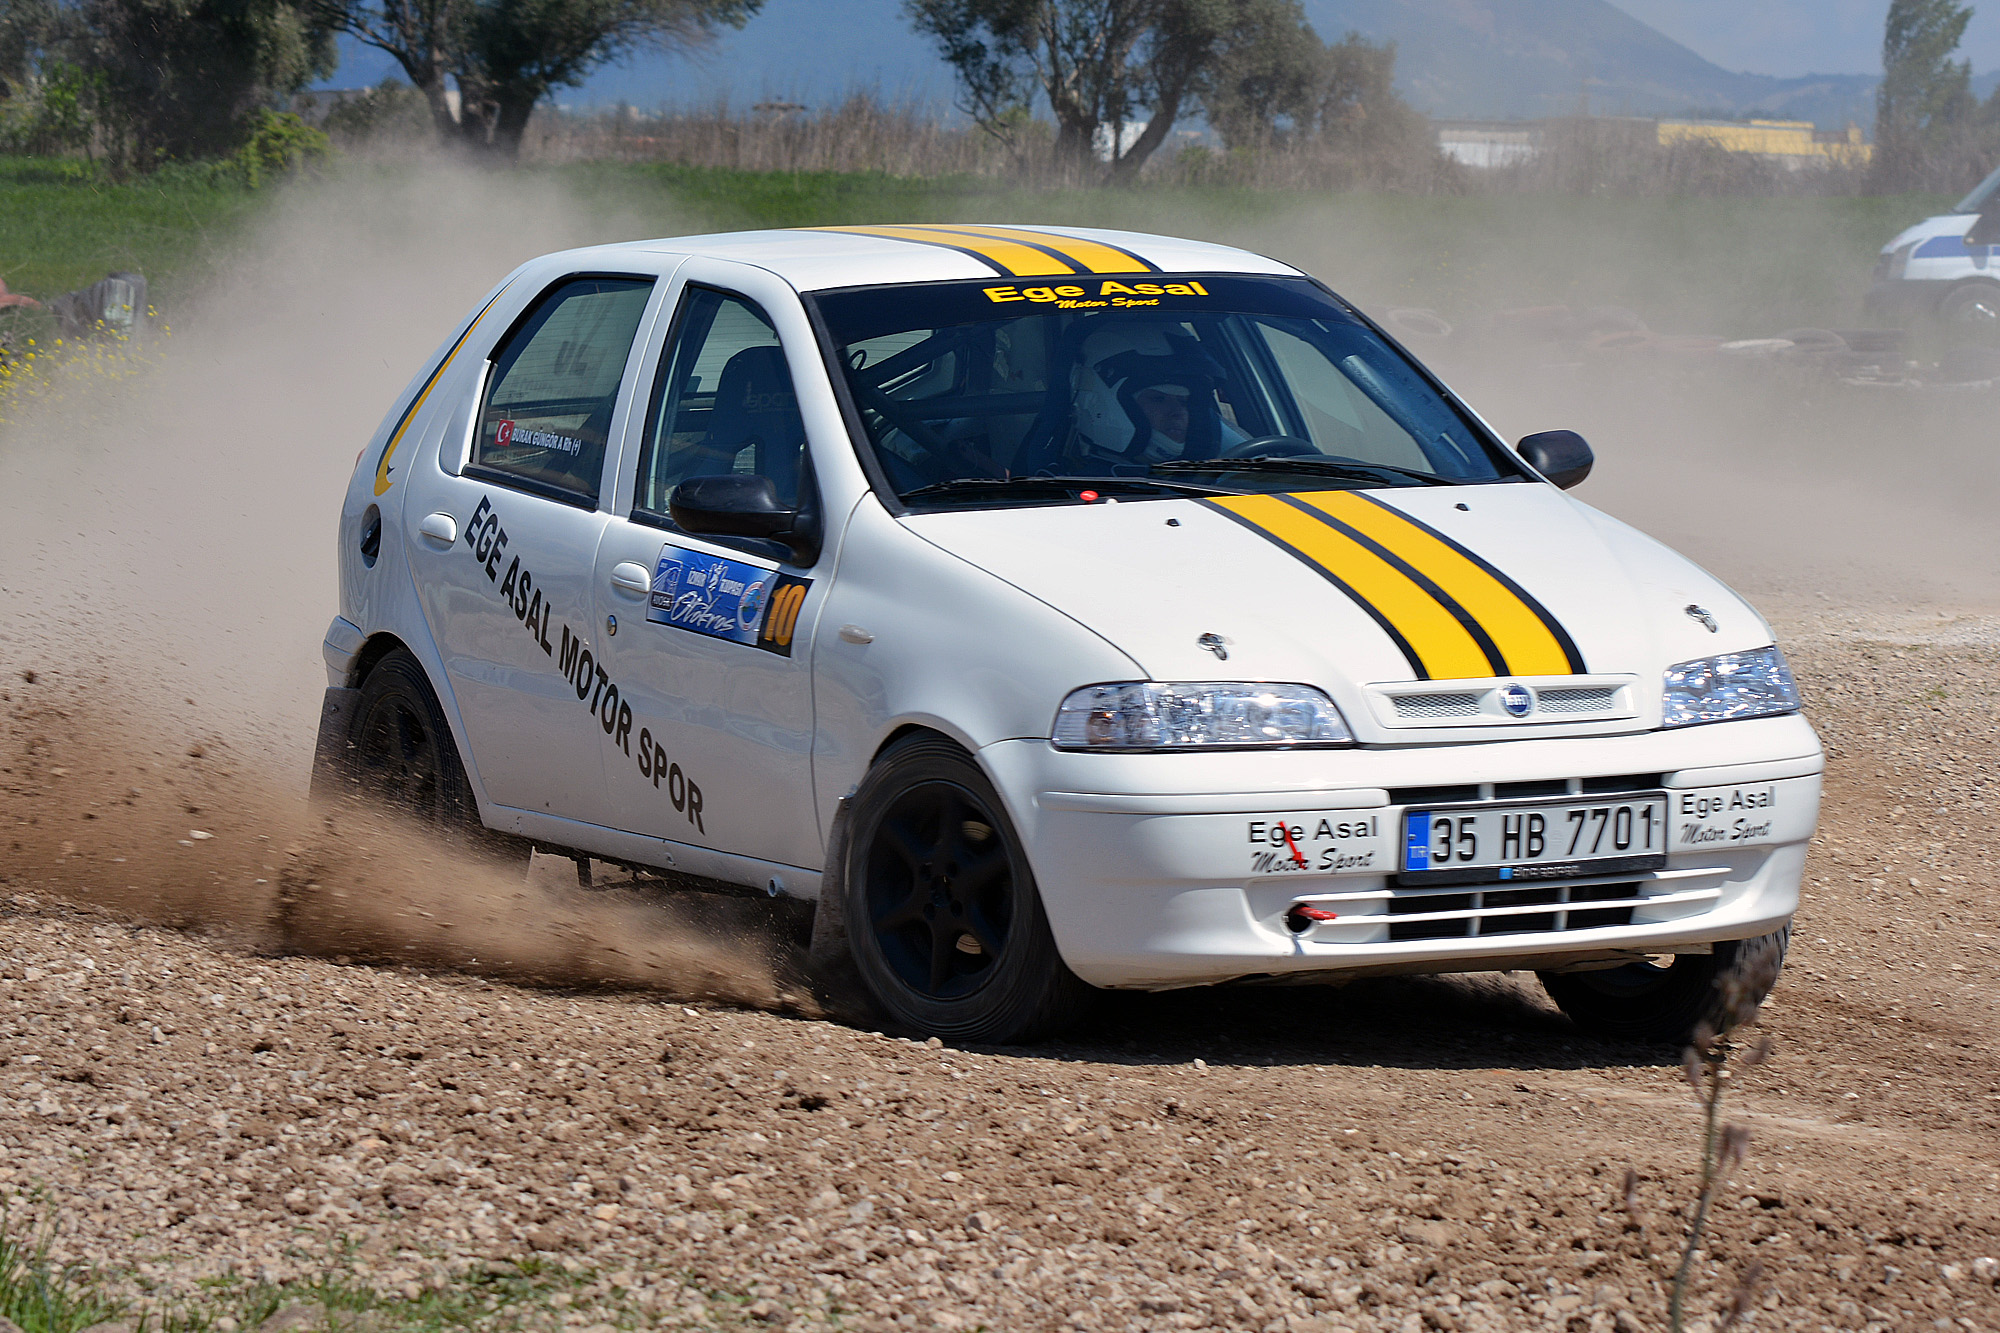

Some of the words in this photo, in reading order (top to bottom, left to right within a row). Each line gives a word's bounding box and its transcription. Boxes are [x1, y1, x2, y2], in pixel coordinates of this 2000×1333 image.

[982, 285, 1085, 303] Ege
[1100, 281, 1209, 296] Asal
[1054, 299, 1109, 309] Motor
[1111, 297, 1160, 308] Sport
[764, 583, 806, 646] 10
[464, 494, 509, 583] EGE
[500, 554, 552, 657] ASAL
[558, 623, 632, 758] MOTOR
[637, 727, 706, 836] SPOR
[1680, 793, 1723, 819] Ege
[1728, 785, 1776, 811] Asal
[1249, 820, 1306, 848] Ege
[1313, 815, 1378, 841] Asal
[1431, 817, 1479, 862] 35
[1502, 812, 1546, 859] HB
[1565, 803, 1654, 856] 7701
[1729, 818, 1773, 845] Sport
[1317, 847, 1376, 875] Sport
